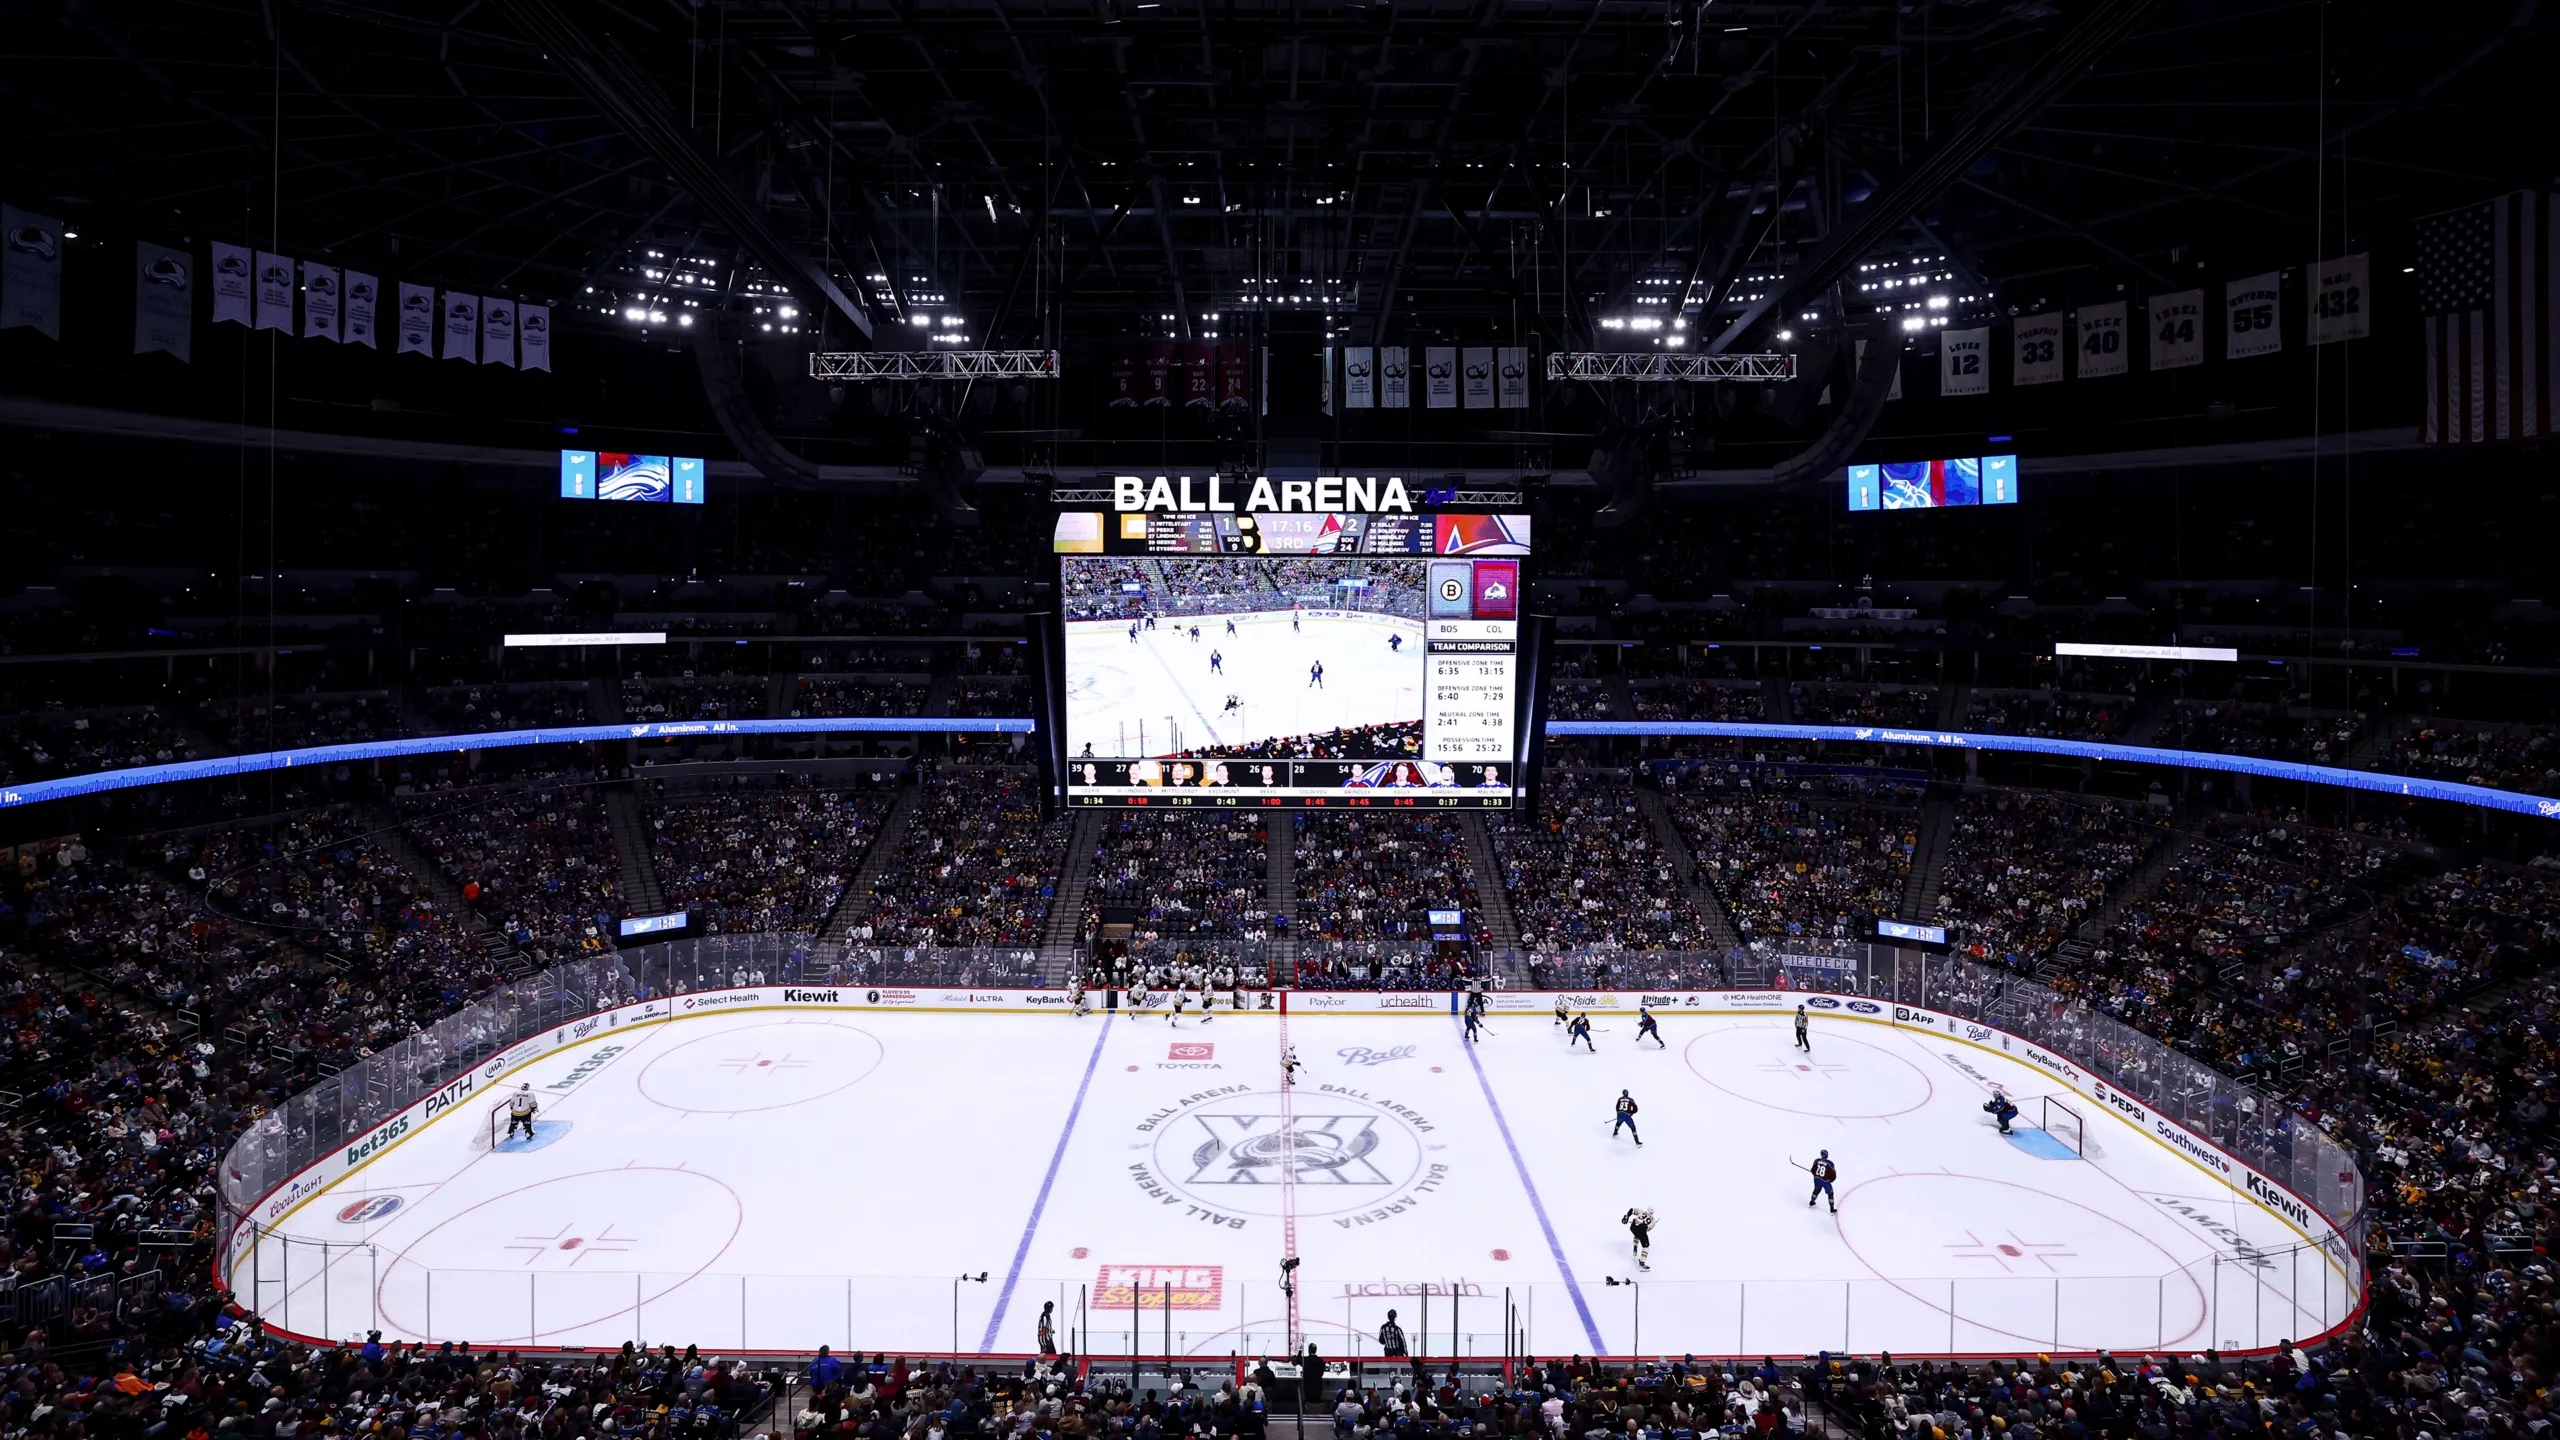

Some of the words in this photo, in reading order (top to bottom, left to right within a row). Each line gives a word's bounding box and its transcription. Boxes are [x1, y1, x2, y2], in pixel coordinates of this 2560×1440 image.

[2315, 287, 2359, 319] 432
[2234, 304, 2272, 333] 55
[2160, 319, 2193, 345] 44
[2084, 330, 2119, 355] 40
[2023, 340, 2054, 364] 33
[1952, 354, 1979, 376] 12
[1154, 377, 1161, 390] 9
[1192, 379, 1206, 391] 22
[1114, 476, 1235, 512] BALL
[1245, 477, 1413, 512] ARENA
[1223, 517, 1229, 531] 1
[1272, 521, 1313, 532] 17:16
[1347, 518, 1357, 531] 2
[1232, 543, 1238, 551] 9
[1274, 537, 1304, 549] 3RD
[1340, 543, 1352, 551] 24
[1440, 625, 1458, 633] BOS
[1486, 625, 1503, 633] COL
[1433, 643, 1456, 651] TEAM
[1457, 643, 1511, 651] COMPARISON
[2119, 648, 2159, 656] Aluminum.
[1438, 667, 1459, 675] 6:35
[1479, 667, 1504, 675] 13:15
[1437, 693, 1459, 701] 6:40
[1483, 693, 1504, 701] 7:29
[658, 724, 708, 734] Aluminum.
[713, 723, 725, 731] All
[727, 723, 738, 731] in.
[1882, 731, 1933, 743] Aluminum.
[1938, 735, 1951, 743] All
[1954, 735, 1966, 744] in.
[1438, 744, 1463, 752] 15:56
[1476, 744, 1502, 752] 25:22
[1116, 765, 1127, 773] 27
[1162, 765, 1170, 773] 11
[1249, 765, 1260, 773] 26
[1472, 766, 1483, 774] 70
[5, 791, 22, 803] in.
[1083, 797, 1103, 805] 0:34
[1127, 797, 1148, 805] 0:58
[1172, 797, 1192, 805] 0:39
[1216, 797, 1236, 805] 0:43
[1262, 797, 1281, 805] 1:00
[1305, 798, 1325, 806] 0:45
[1350, 798, 1370, 806] 0:45
[1394, 798, 1414, 806] 0:45
[1438, 798, 1458, 806] 0:37
[1482, 798, 1502, 806] 0:33
[633, 919, 653, 933] Ball
[1890, 925, 1909, 936] Ball
[697, 995, 734, 1006] Select
[736, 993, 759, 1003] Health
[784, 989, 839, 1003] Kiewit
[1026, 996, 1065, 1005] KeyBank
[1145, 993, 1169, 1008] Ball
[1309, 996, 1347, 1008] Paycor
[1381, 994, 1433, 1007] uchealth
[1813, 997, 1835, 1008] Ford
[1852, 1002, 1875, 1013] Ford
[573, 1016, 599, 1038] Ball
[1966, 1025, 1993, 1041] Ball
[1337, 1044, 1417, 1066] Ball
[2027, 1048, 2063, 1073] KeyBank
[488, 1061, 502, 1075] IMA
[546, 1046, 625, 1089] bet365
[1156, 1062, 1222, 1070] TOYOTA
[1943, 1053, 1989, 1082] KeyBank
[425, 1074, 472, 1119] PATH
[518, 1097, 522, 1107] 1
[1136, 1107, 1178, 1132] BALL
[1179, 1084, 1252, 1107] ARENA
[1319, 1084, 1370, 1101] BALL
[1377, 1100, 1435, 1134] ARENA
[2110, 1093, 2145, 1123] PEPSI
[347, 1115, 409, 1166] bet365
[2157, 1121, 2221, 1170] Southwest
[1816, 1165, 1826, 1177] 28
[1414, 1162, 1449, 1193] BALL
[297, 1175, 323, 1199] LIGHT
[1128, 1162, 1182, 1206] ARENA
[2247, 1171, 2310, 1229] Kiewit
[1185, 1203, 1247, 1230] BALL
[1333, 1194, 1418, 1229] ARENA
[1106, 1269, 1212, 1287] KING
[1345, 1276, 1484, 1297] uchealth
